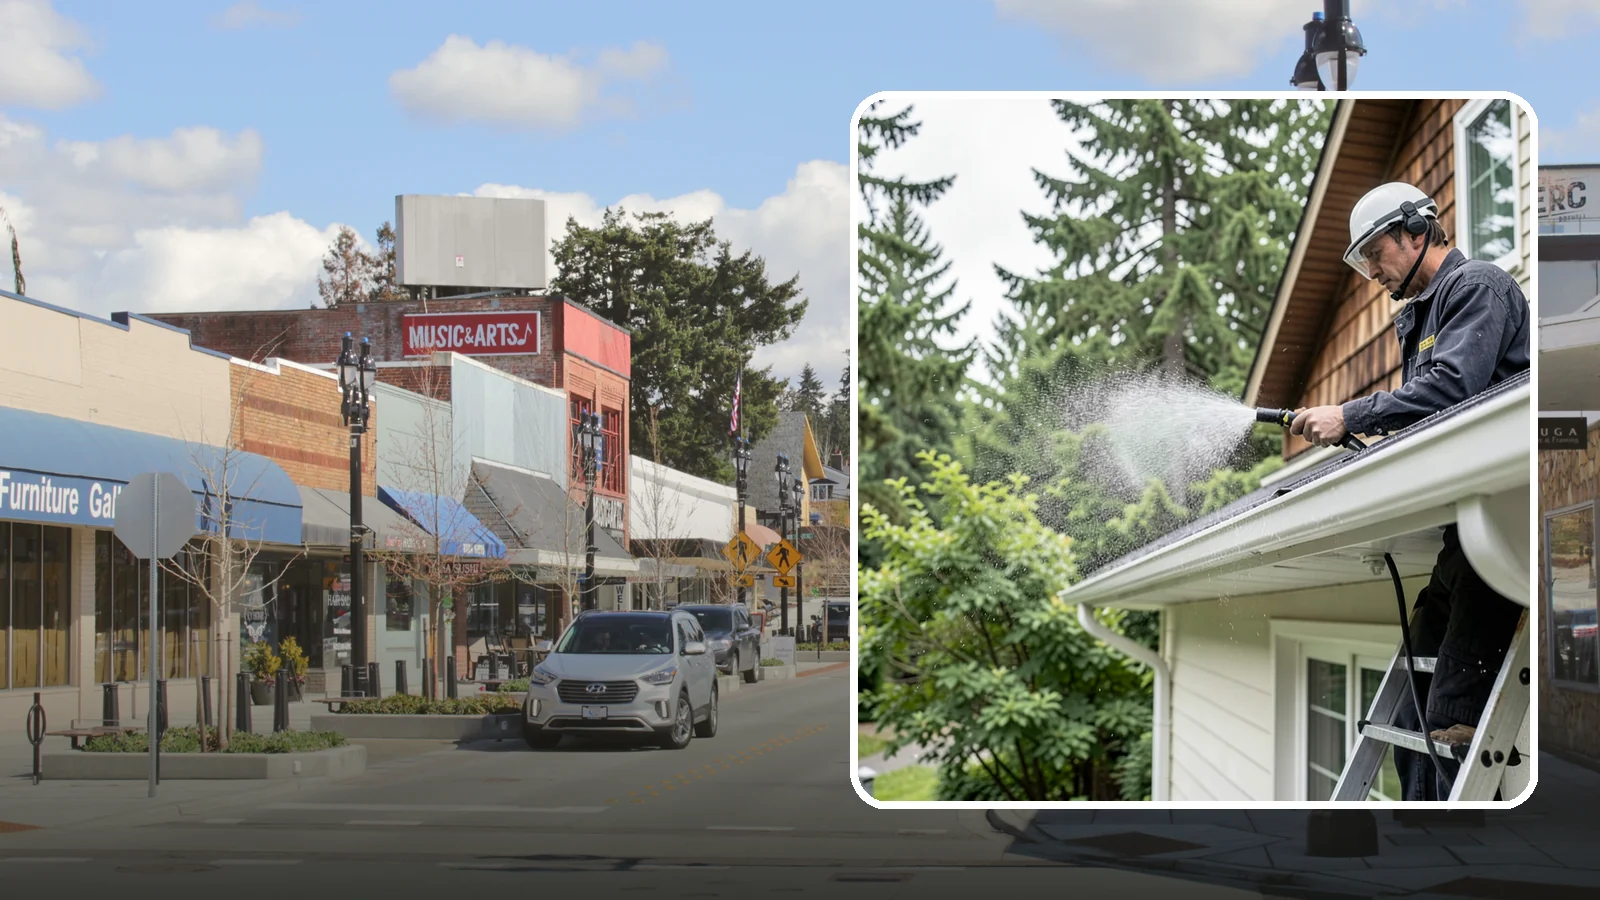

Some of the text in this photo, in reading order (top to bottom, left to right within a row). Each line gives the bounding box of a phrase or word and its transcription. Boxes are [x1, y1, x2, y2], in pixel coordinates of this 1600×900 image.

[0, 471, 122, 519] Furniture Gal
[453, 563, 479, 574] SUSHI
